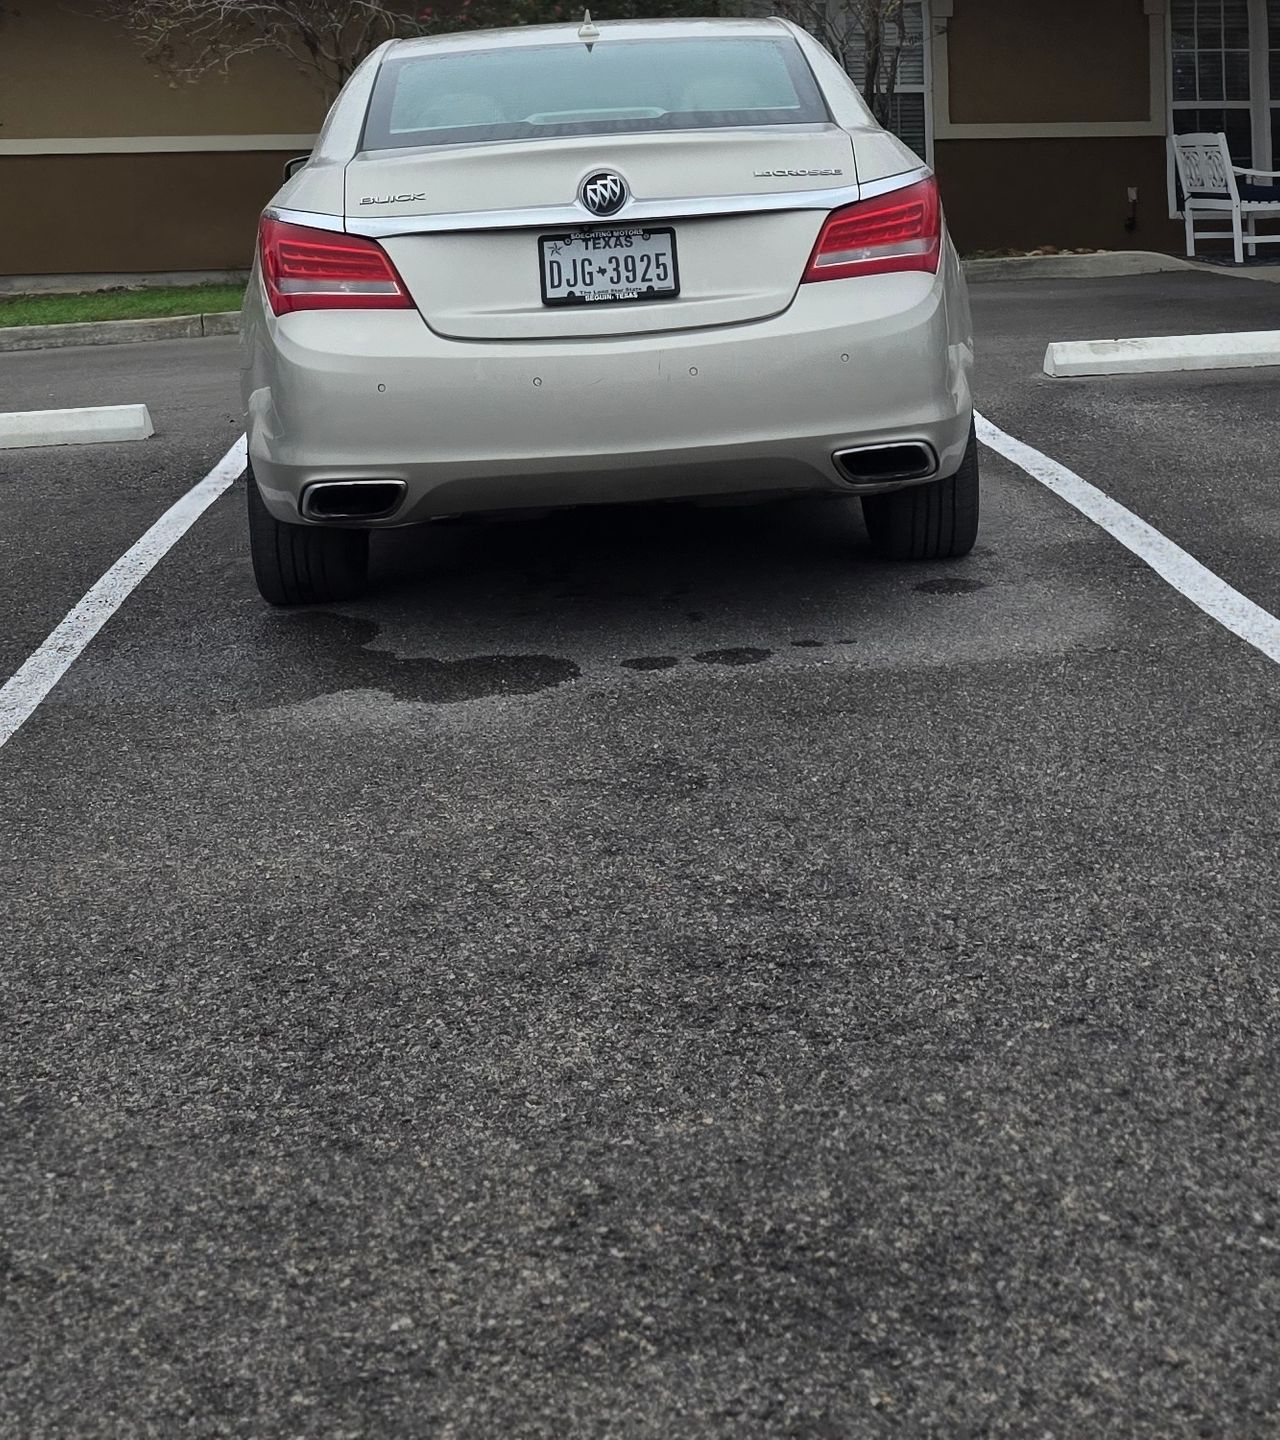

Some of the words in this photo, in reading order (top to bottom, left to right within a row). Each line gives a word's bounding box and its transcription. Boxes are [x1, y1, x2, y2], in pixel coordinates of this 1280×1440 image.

[359, 192, 426, 206] BUICK
[570, 231, 612, 240] SOECHTING
[613, 229, 644, 237] MOTORS
[582, 237, 634, 251] TEXAS
[548, 258, 595, 290] DJG
[608, 252, 669, 286] 3925
